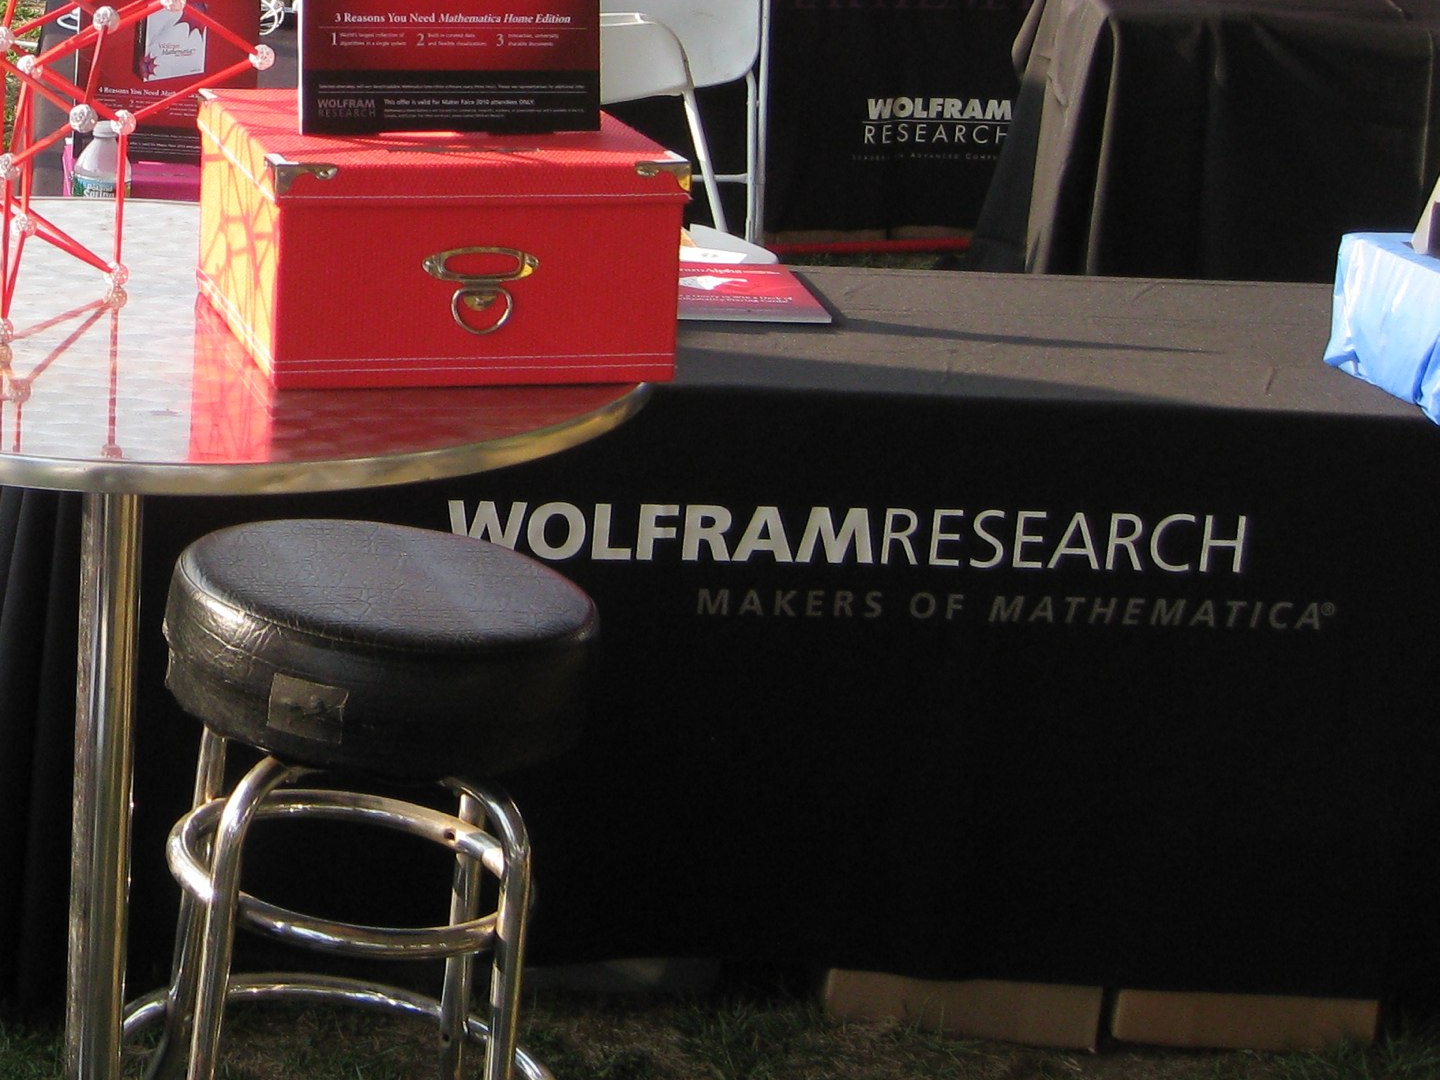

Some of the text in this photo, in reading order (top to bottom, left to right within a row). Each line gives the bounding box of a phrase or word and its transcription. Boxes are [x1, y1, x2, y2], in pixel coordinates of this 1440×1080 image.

[334, 12, 571, 24] 3 Reasons You Need Mathematica Home Edition
[331, 32, 337, 46] 1
[416, 32, 425, 47] 2
[496, 33, 504, 47] 3
[317, 99, 375, 108] WOLFRAM
[867, 96, 1012, 120] WOLFRAM
[318, 108, 376, 118] RESEARCH
[447, 499, 1246, 573] WOLFRAMRESEARCH
[696, 587, 884, 619] MAKERS
[909, 591, 964, 620] OF
